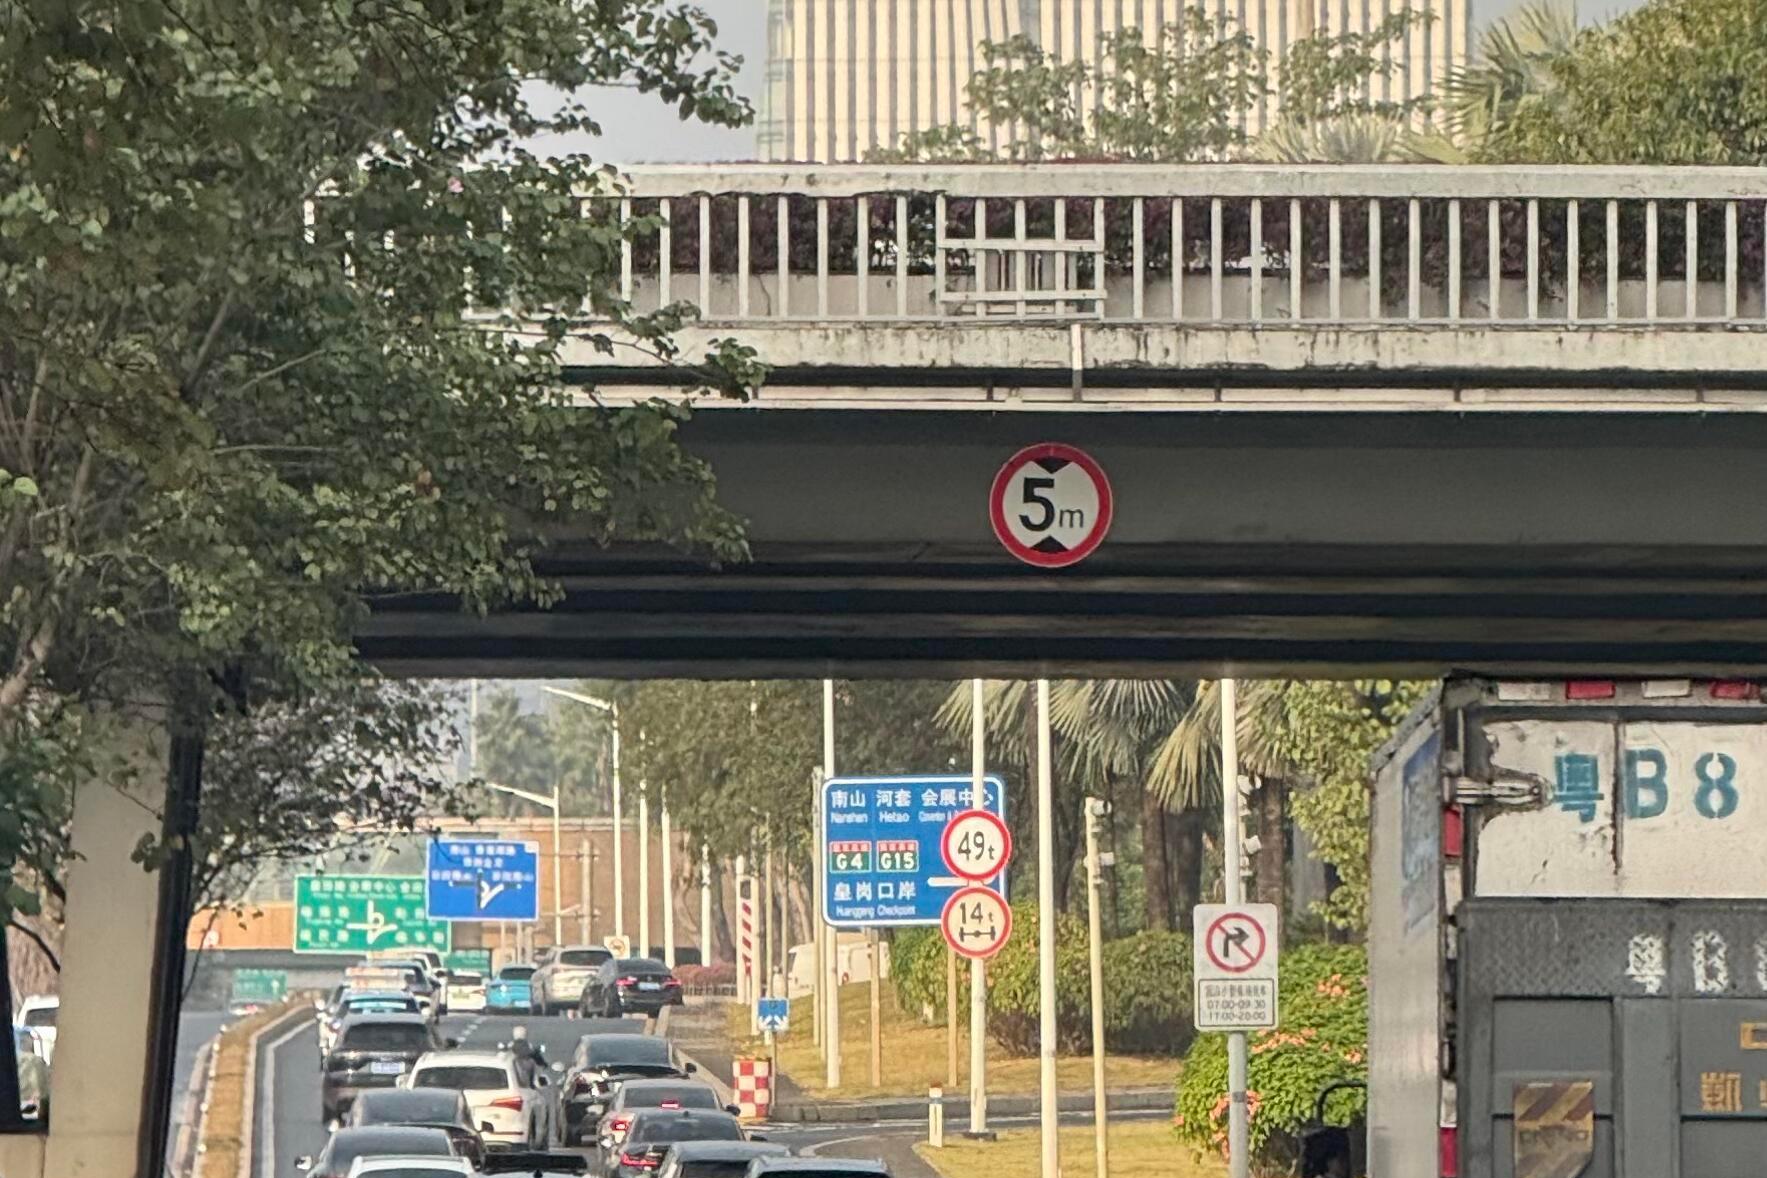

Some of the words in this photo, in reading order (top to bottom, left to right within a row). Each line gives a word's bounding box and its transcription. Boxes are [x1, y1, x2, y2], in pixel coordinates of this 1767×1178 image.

[1018, 477, 1084, 532] 5m
[831, 790, 866, 808] 南山
[876, 789, 911, 808] 河套
[879, 811, 910, 823] Hetao
[836, 853, 863, 870] G4
[881, 852, 914, 869] G15
[834, 881, 916, 901] 皇岗口岸
